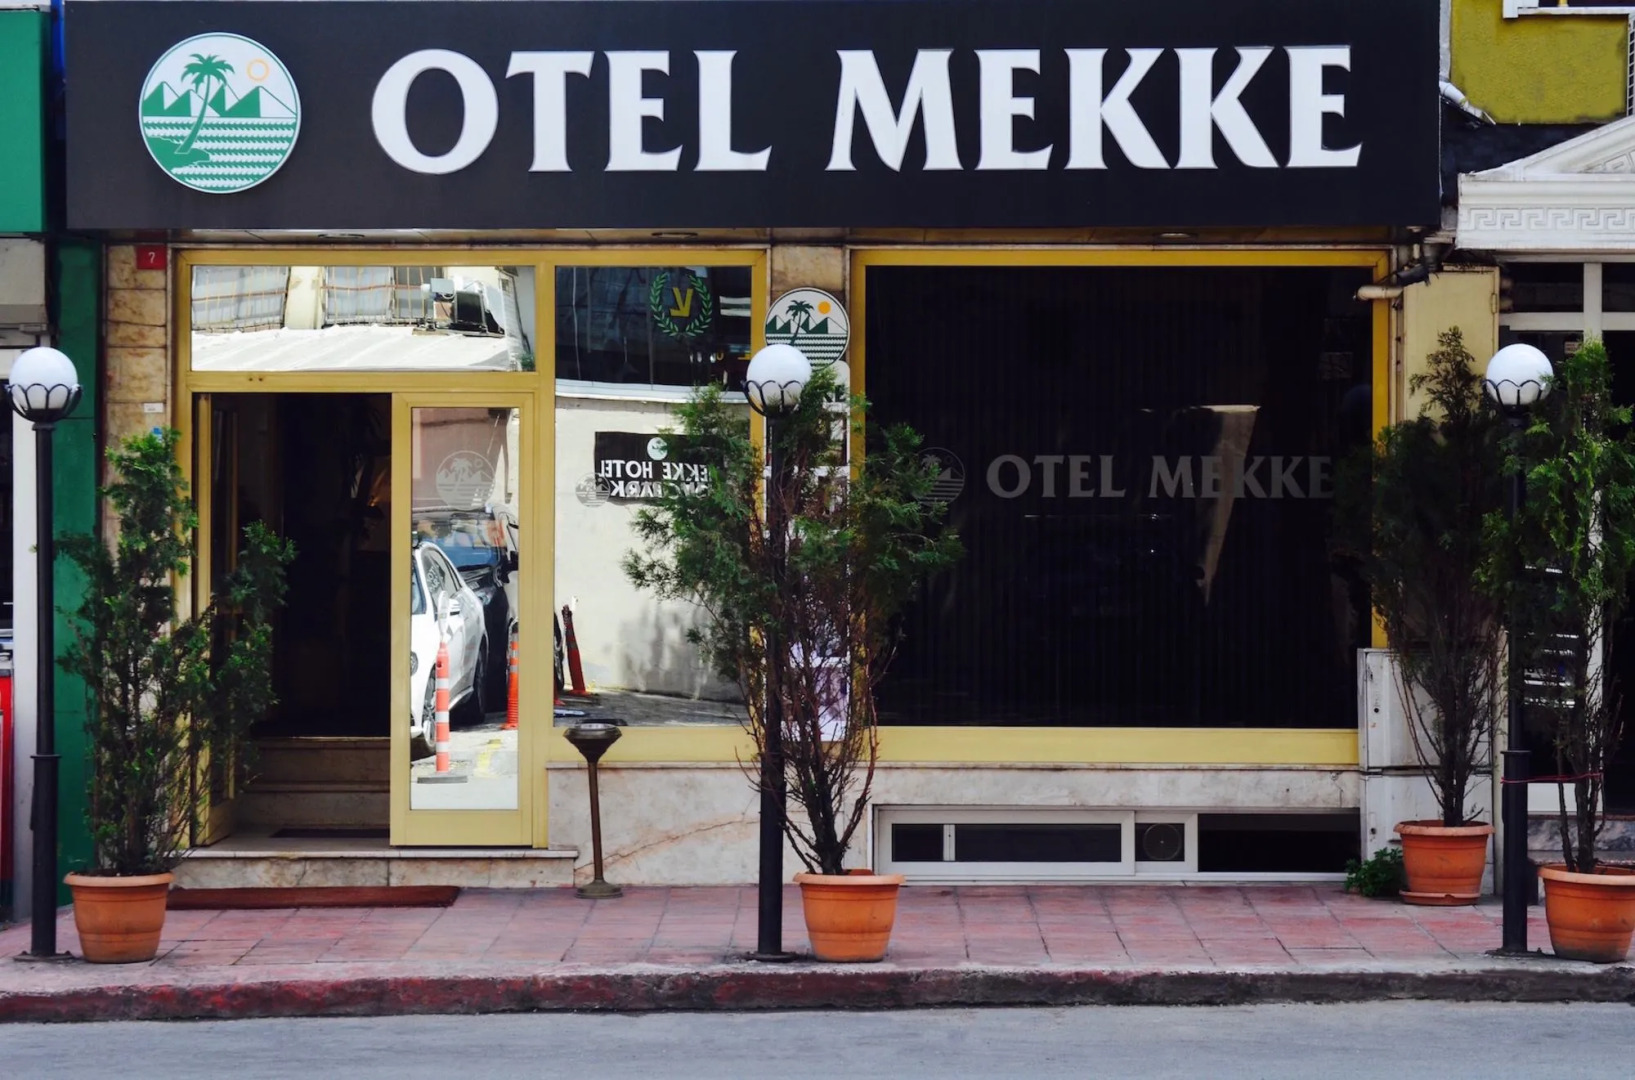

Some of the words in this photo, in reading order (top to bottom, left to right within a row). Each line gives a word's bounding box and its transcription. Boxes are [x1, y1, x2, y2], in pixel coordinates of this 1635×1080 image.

[372, 48, 771, 174] OTEL
[826, 45, 1362, 172] MEKKE
[148, 251, 156, 264] 7
[986, 454, 1126, 498] OTEL
[1148, 455, 1334, 498] MEKKE
